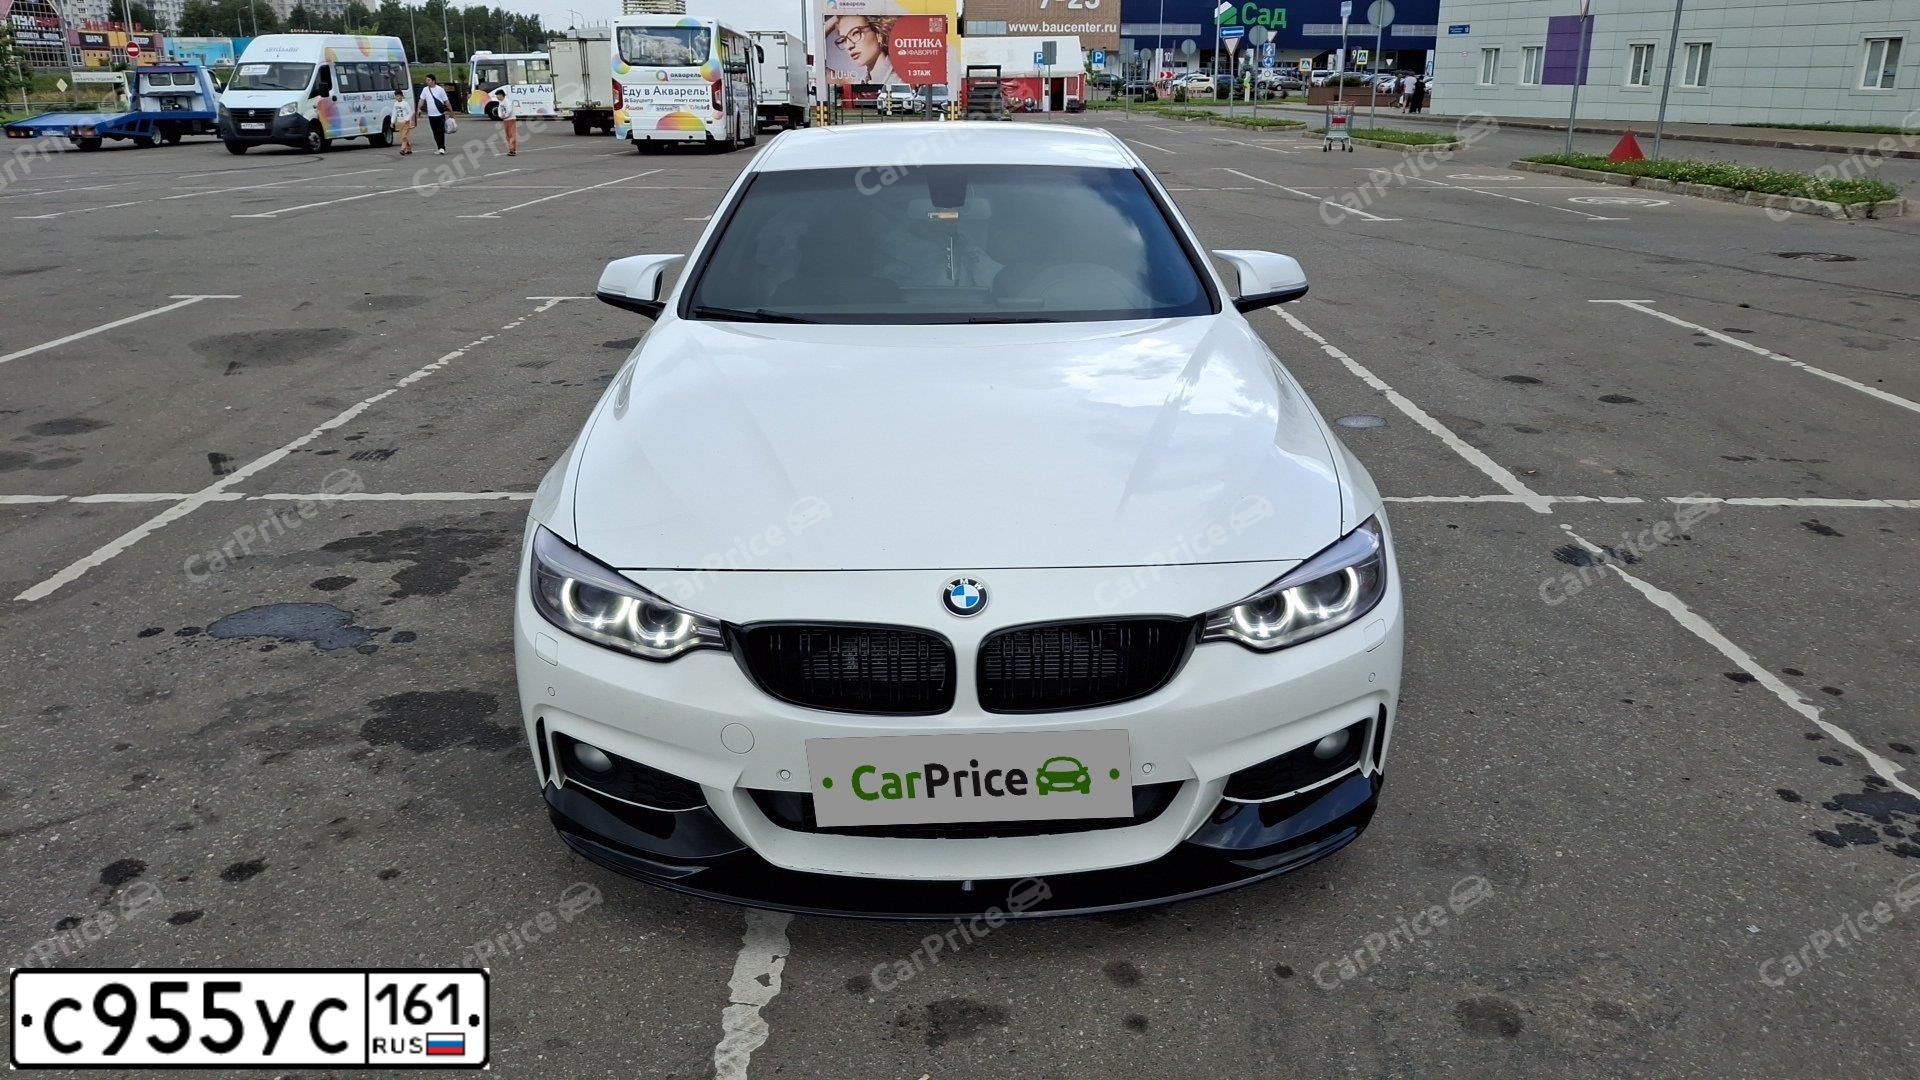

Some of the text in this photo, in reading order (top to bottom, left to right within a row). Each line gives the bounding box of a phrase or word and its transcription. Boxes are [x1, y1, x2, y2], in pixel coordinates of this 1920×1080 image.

[1242, 2, 1287, 28] Сад
[1008, 21, 1117, 33] www.baucenter.ru
[894, 38, 943, 48] ОПТИКА
[1094, 52, 1102, 62] P
[510, 85, 527, 95] Еду
[538, 85, 553, 94] Ак
[622, 86, 709, 97] Еду в Акварель!
[946, 578, 984, 591] BMW
